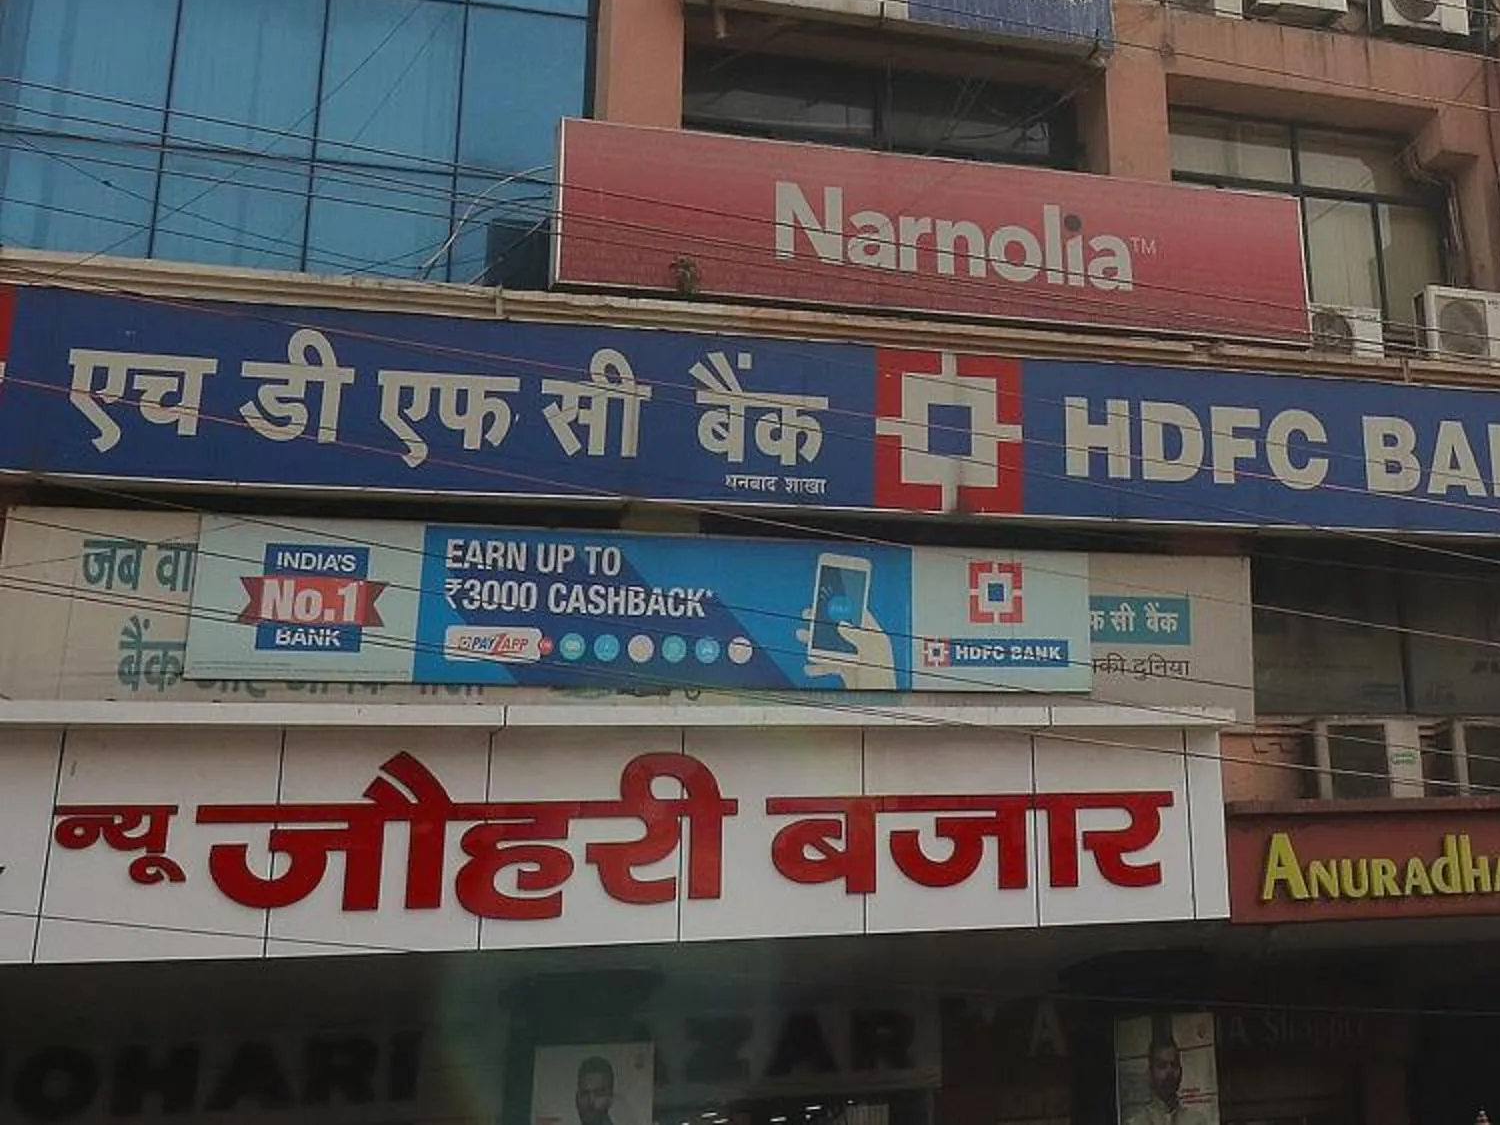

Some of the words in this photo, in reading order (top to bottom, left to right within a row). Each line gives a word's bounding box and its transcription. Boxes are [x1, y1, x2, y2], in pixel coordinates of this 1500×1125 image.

[774, 181, 1134, 292] Narnolia
[68, 349, 217, 452] एच
[237, 328, 355, 444] डी
[378, 370, 521, 468] एफ
[541, 348, 652, 458] सी
[688, 351, 829, 467] बैंक
[1063, 396, 1330, 490] HDFC
[725, 474, 778, 492] धनबाद
[784, 477, 827, 494] शाखा
[83, 539, 147, 591] जब
[276, 551, 357, 572] INDIA'S
[445, 538, 527, 572] EARN
[537, 543, 576, 574] UP
[585, 546, 622, 576] TO
[260, 578, 360, 622] No.1
[444, 578, 538, 612] ₹3000
[275, 628, 341, 648] BANK
[955, 643, 1006, 662] HDFC
[1010, 645, 1063, 663] BANK
[54, 806, 186, 885] न्यू
[195, 751, 738, 921] जौहरी
[766, 790, 1174, 896] बजार
